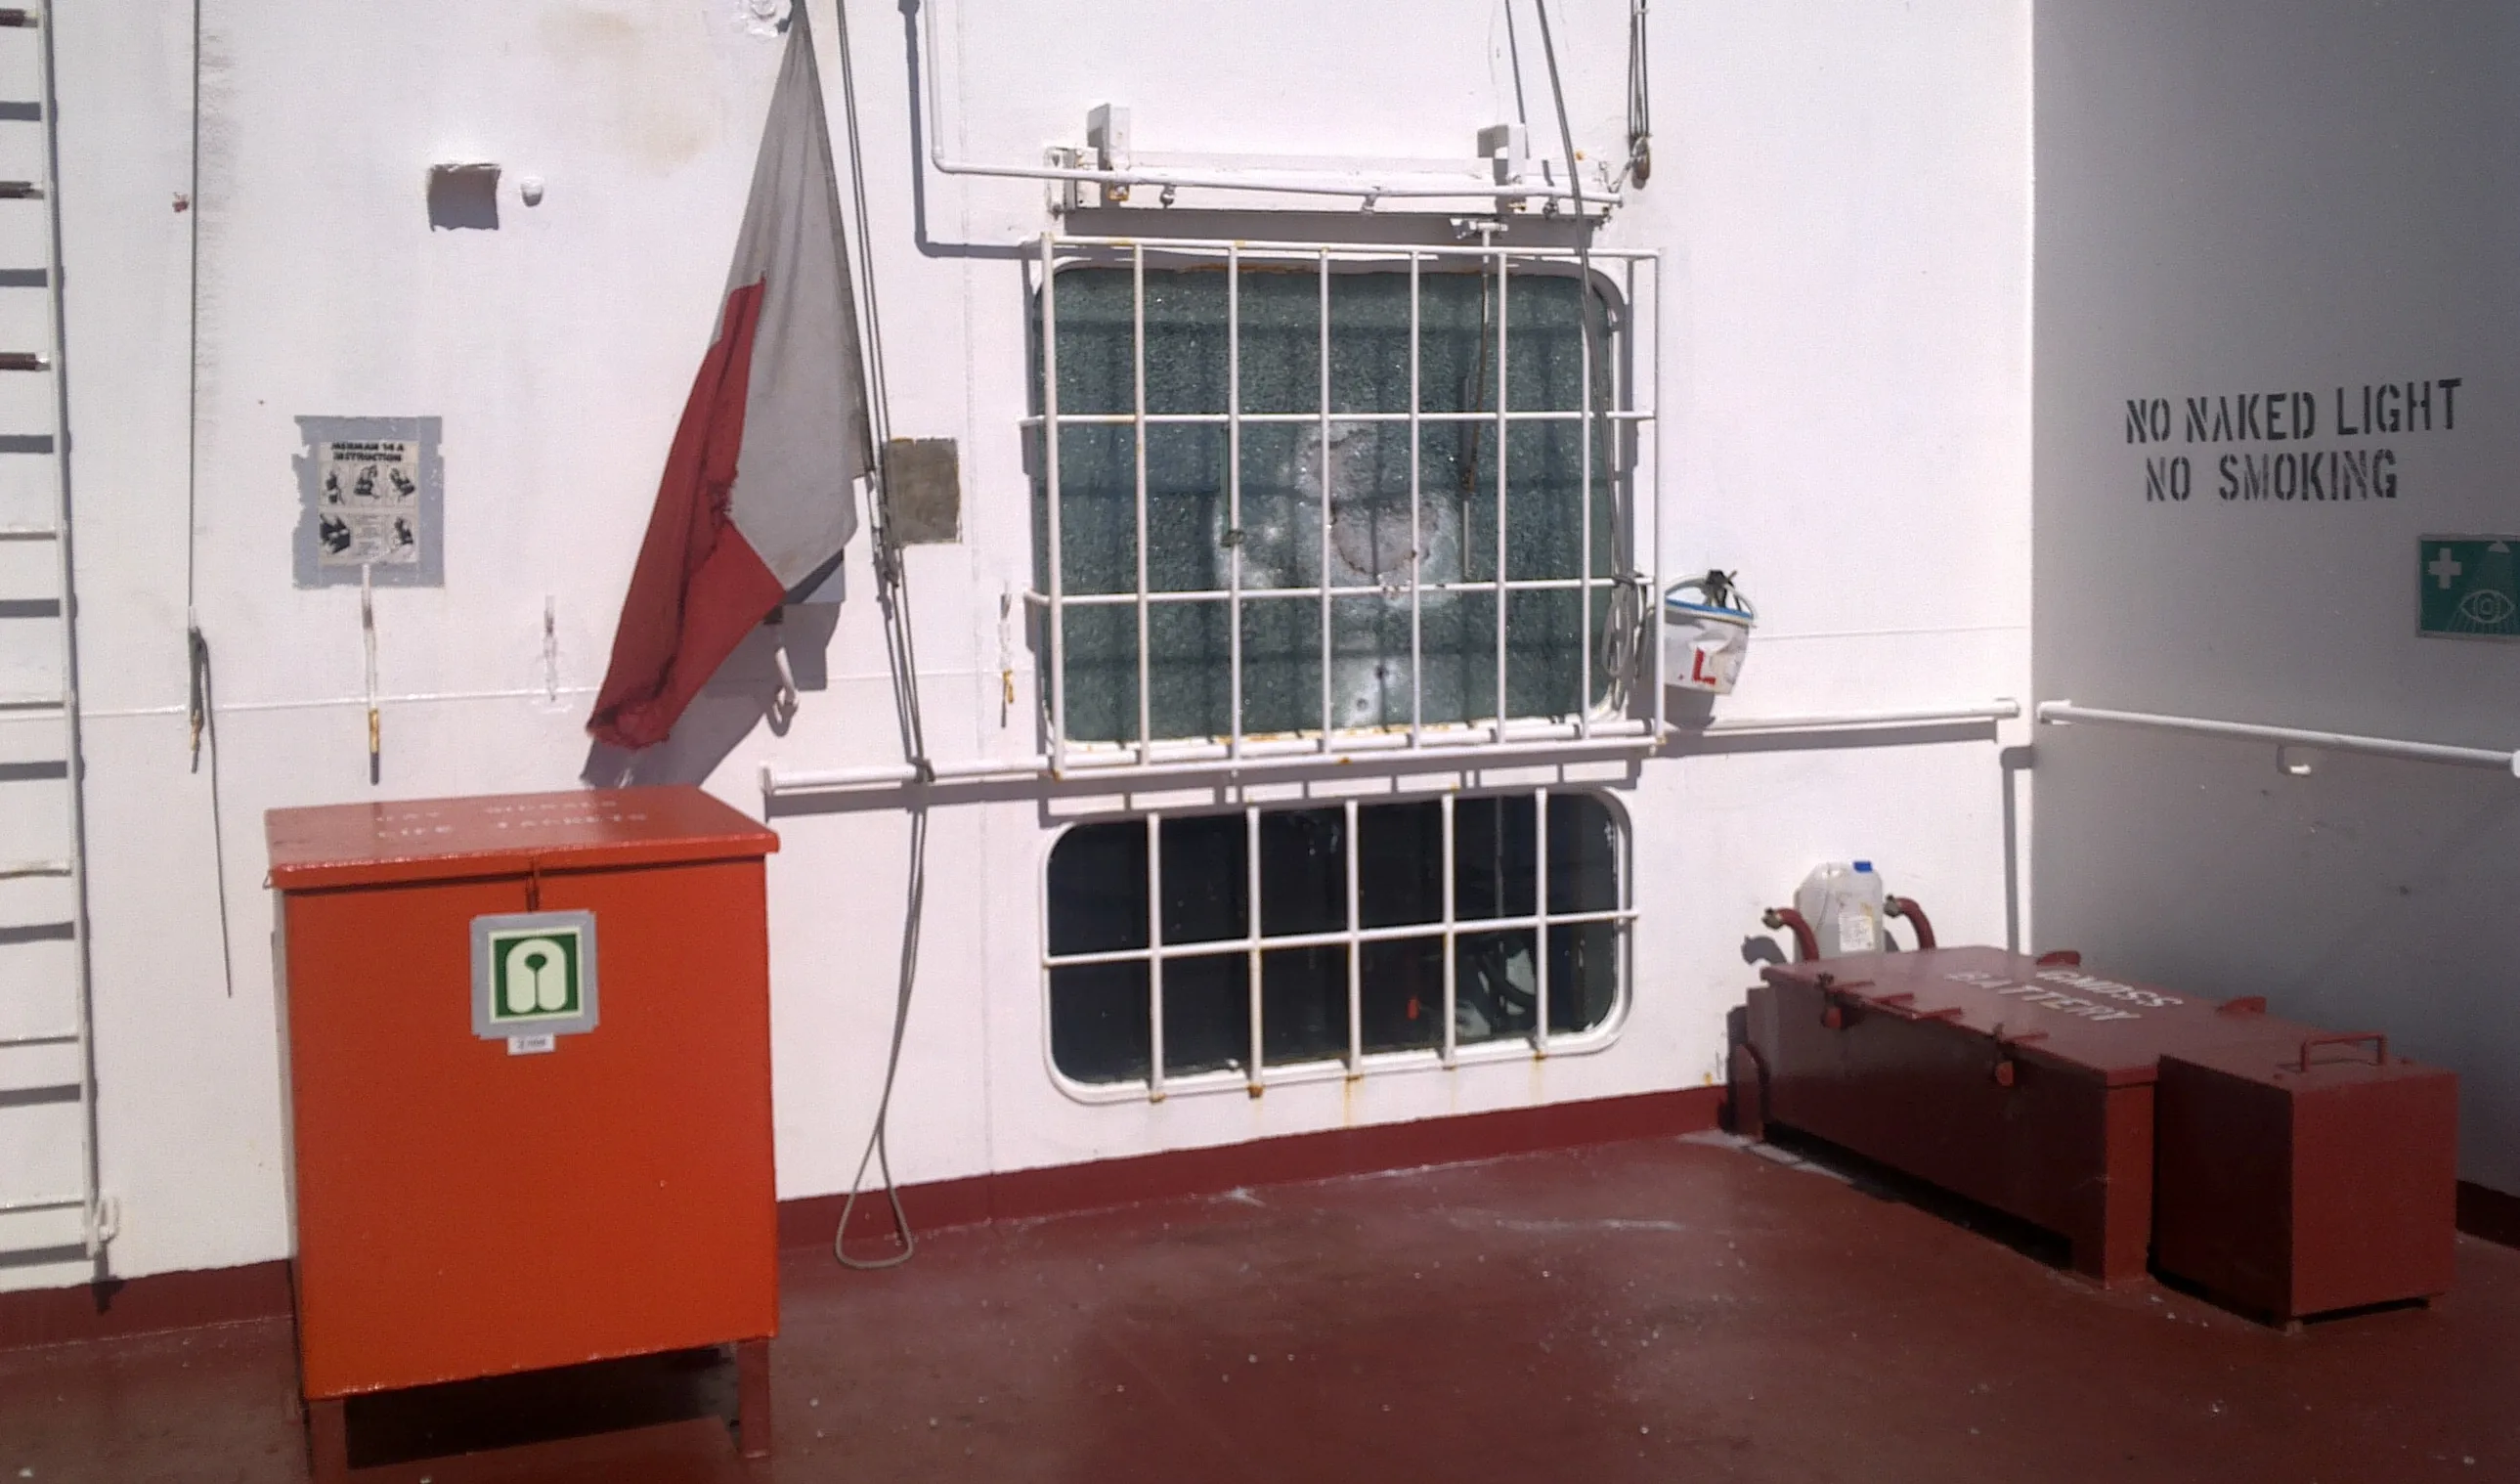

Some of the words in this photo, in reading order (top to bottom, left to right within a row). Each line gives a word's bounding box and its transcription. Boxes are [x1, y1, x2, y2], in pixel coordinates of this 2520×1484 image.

[2126, 397, 2171, 444] NO
[2186, 392, 2316, 444] NAKED
[2336, 377, 2463, 436] LIGHT
[332, 451, 403, 462] INSTRUCTION
[2146, 456, 2192, 502] NO
[2218, 449, 2399, 502] SMOKING
[1944, 971, 2143, 1021] BATTERY
[2036, 970, 2185, 1007] GMDSS
